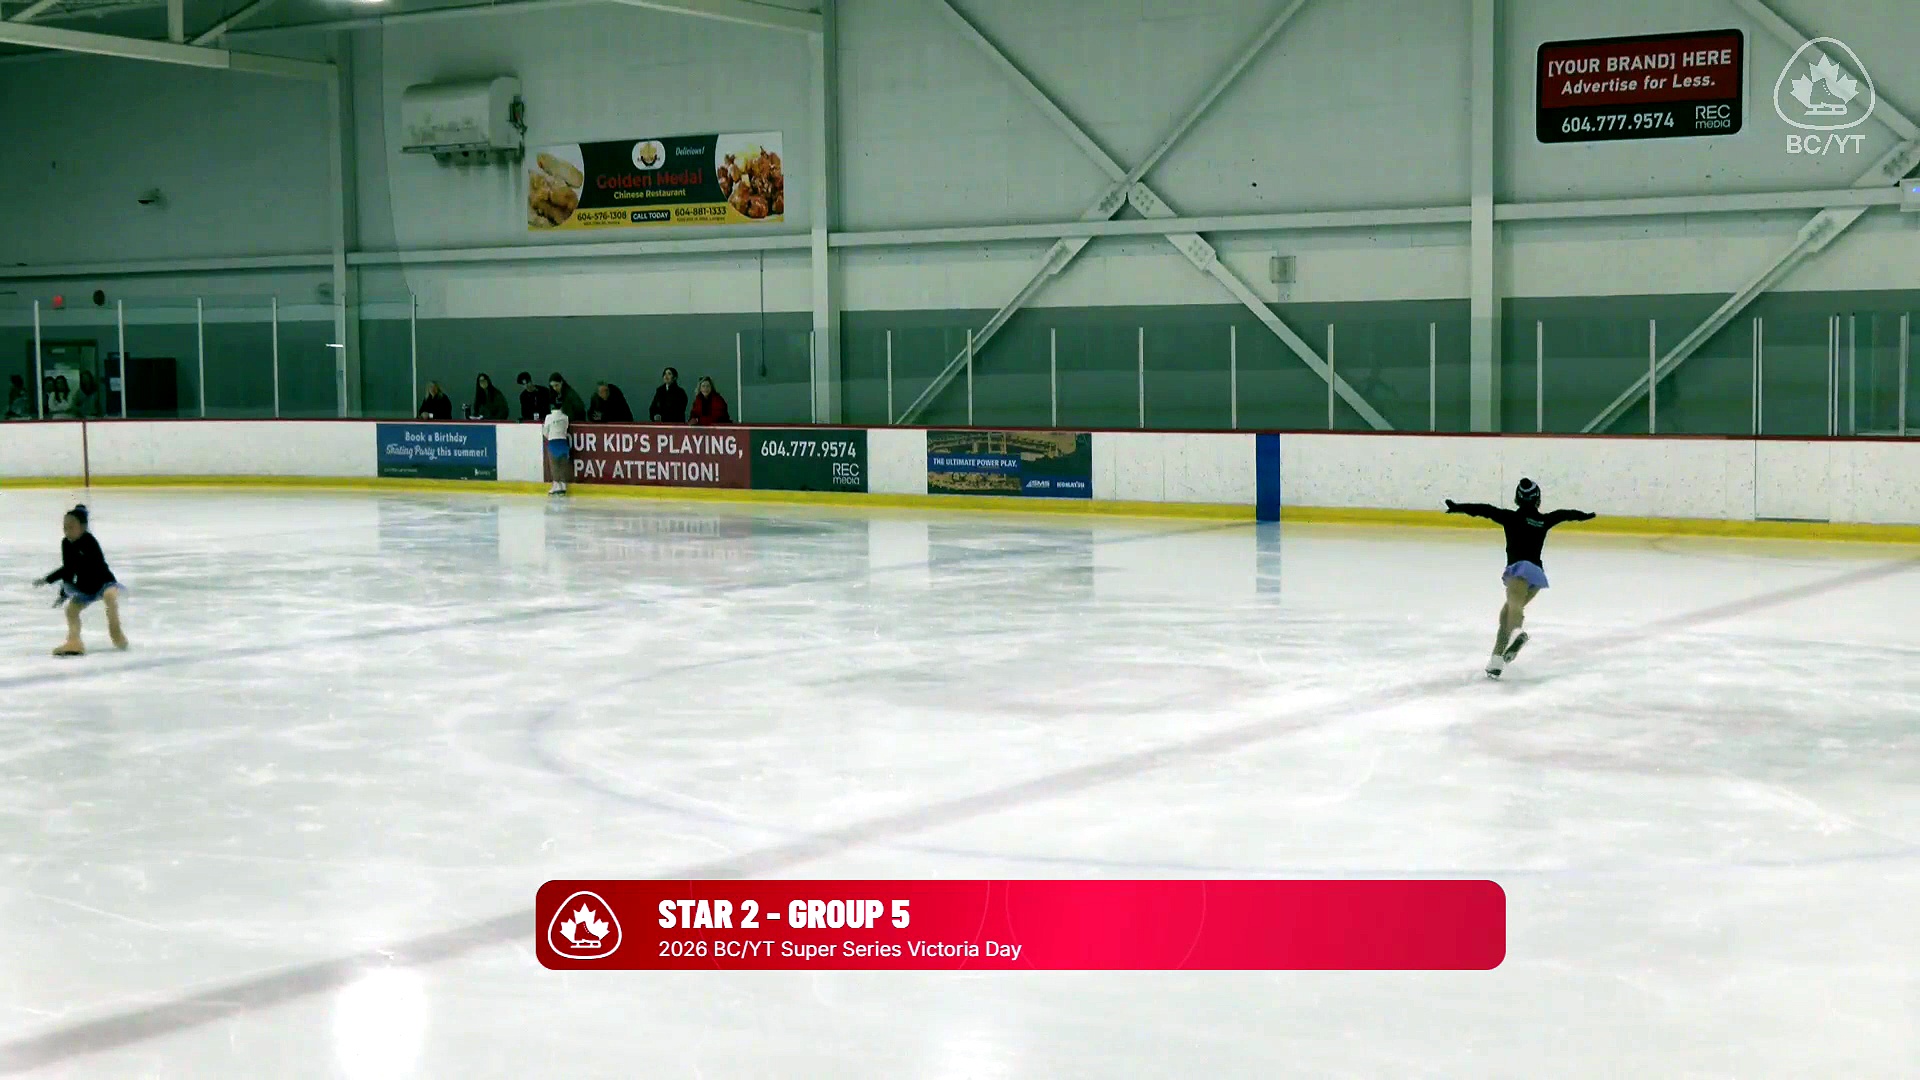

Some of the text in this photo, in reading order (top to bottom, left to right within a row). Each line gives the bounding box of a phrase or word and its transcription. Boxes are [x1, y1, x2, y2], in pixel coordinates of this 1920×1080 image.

[1548, 49, 1732, 77] [YOUR BRAND] HERE
[1561, 70, 1716, 95] Advertise for Less.
[1695, 104, 1731, 120] REC
[1561, 112, 1675, 134] 604.777.9574
[1695, 118, 1731, 129] media
[675, 147, 705, 156] Delicious!
[597, 169, 702, 190] Golden Medal
[613, 188, 687, 200] Chinese Restaurant
[577, 210, 627, 221] 604-576-1308
[632, 212, 648, 220] CALL
[649, 211, 669, 220] TODAY
[674, 206, 727, 217] 604-881-1333
[405, 431, 467, 444] Book a Birthday
[386, 443, 413, 458] Skating
[437, 446, 451, 456] this
[453, 448, 487, 457] summer!
[603, 433, 650, 452] KID'S
[657, 434, 743, 459] PLAYING,
[761, 440, 856, 458] 604.777.9574
[946, 458, 976, 466] ULTIMATE
[977, 459, 999, 467] POWER
[1000, 459, 1017, 467] PLAY.
[573, 459, 720, 482] PAY ATTENTION!
[832, 463, 859, 476] REC
[832, 475, 860, 485] media
